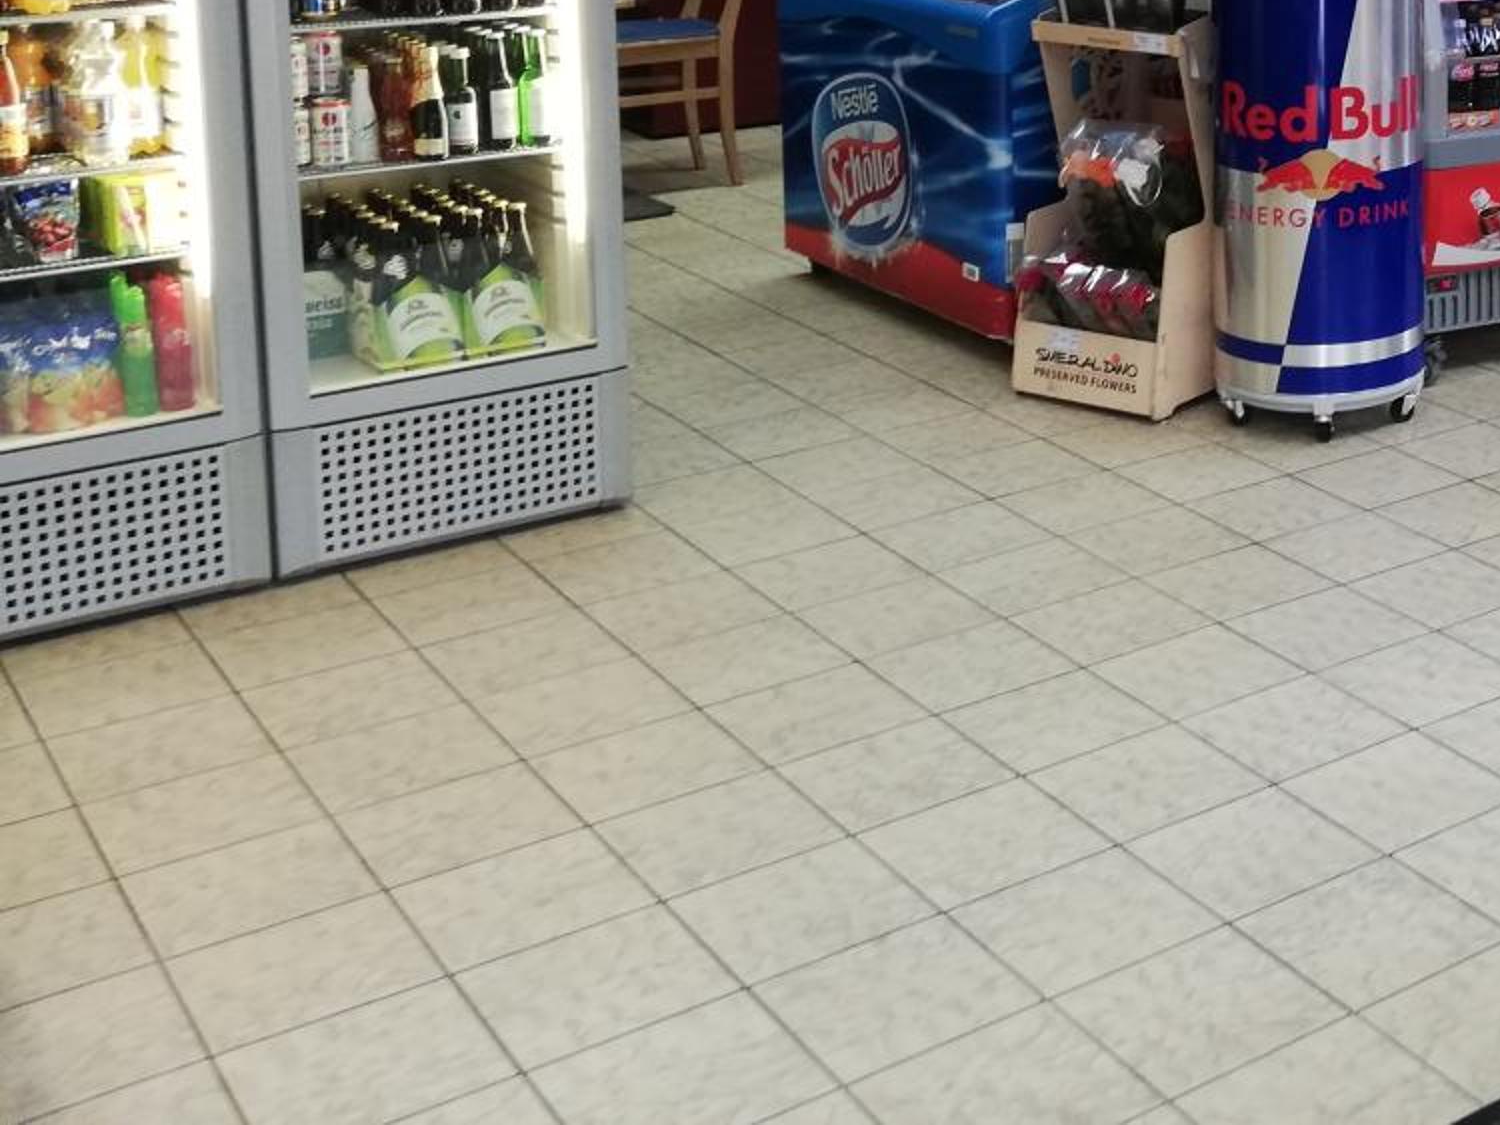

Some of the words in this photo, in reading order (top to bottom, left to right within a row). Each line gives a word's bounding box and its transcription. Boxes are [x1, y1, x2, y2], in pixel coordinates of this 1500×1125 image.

[830, 83, 879, 121] Nestlé
[1221, 78, 1320, 143] Red
[1329, 74, 1421, 140] Bull
[826, 145, 902, 217] Schöller
[1225, 200, 1328, 229] ENERGY
[1338, 199, 1409, 228] DRINK
[1033, 366, 1089, 386] PRESERVED
[1089, 377, 1137, 394] FLOWERS
